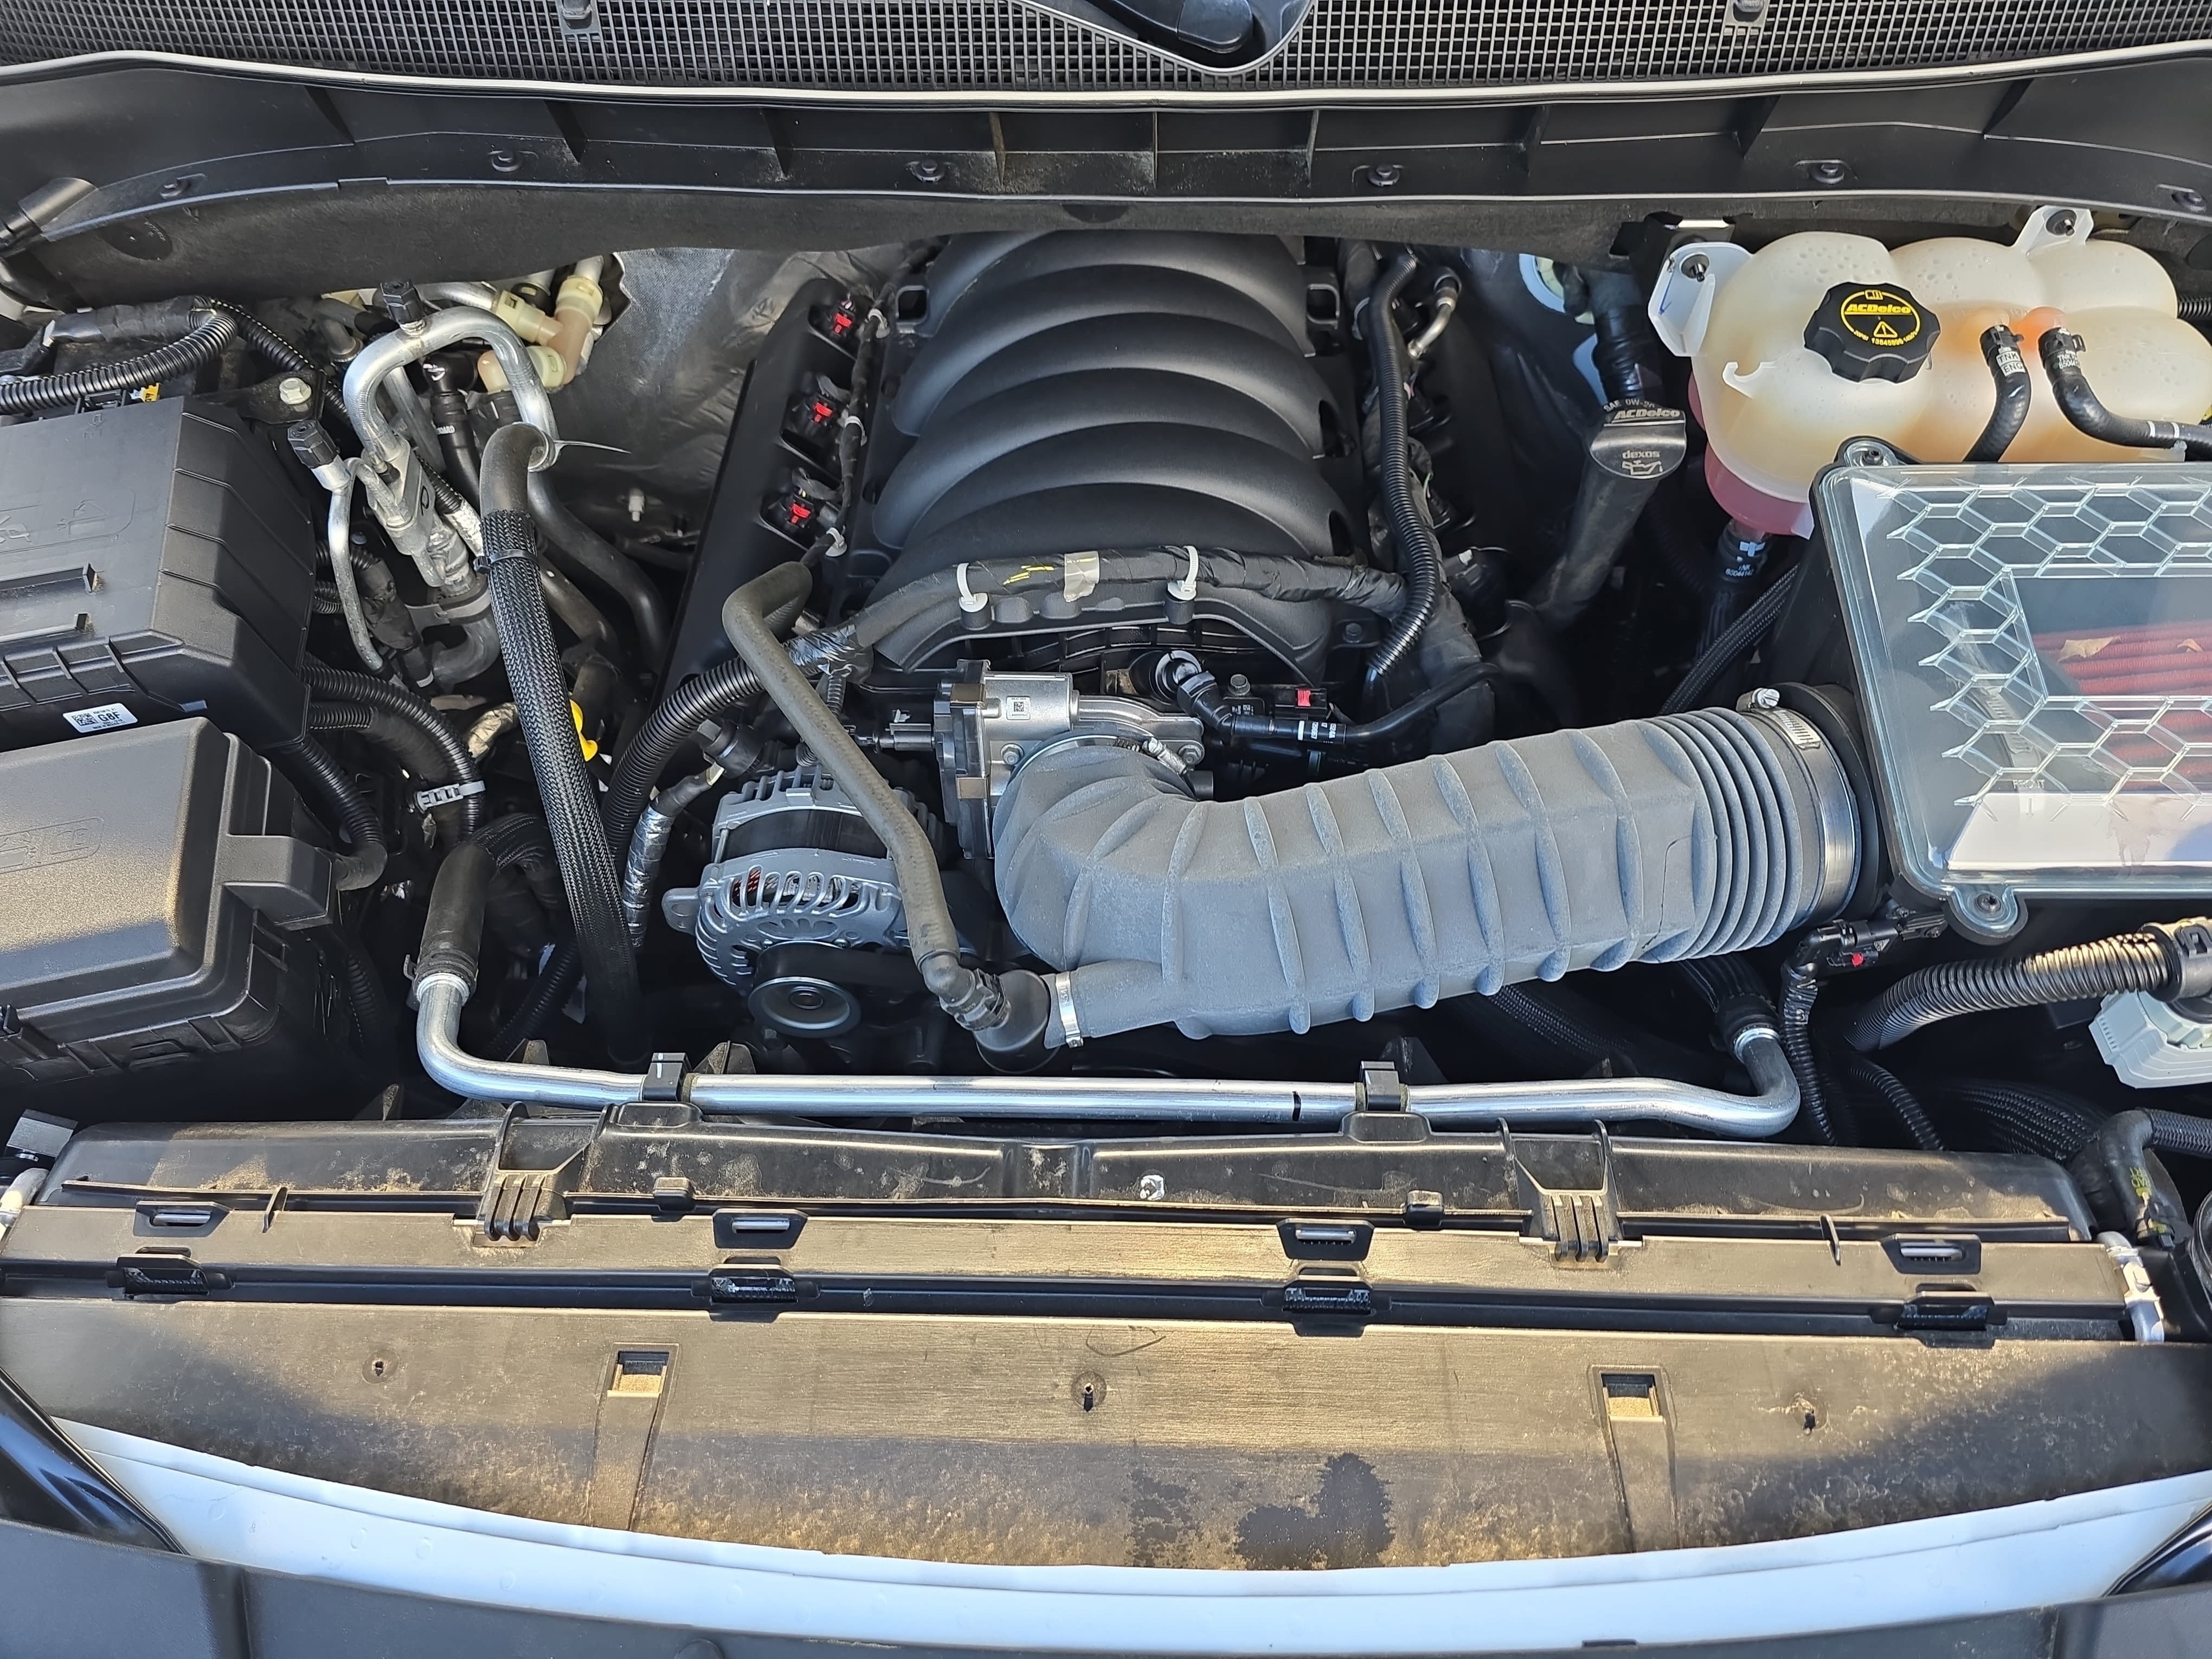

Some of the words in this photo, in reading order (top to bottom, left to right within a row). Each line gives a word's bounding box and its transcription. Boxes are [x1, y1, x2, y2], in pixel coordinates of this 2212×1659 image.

[1846, 304, 1911, 314] ACDelco
[1998, 353, 2019, 363] TNK
[2003, 362, 2023, 373] ENG
[1603, 400, 1622, 412] SAE
[1613, 408, 1680, 420] ACDelco
[1622, 450, 1661, 459] dexos
[98, 711, 120, 722] G8F
